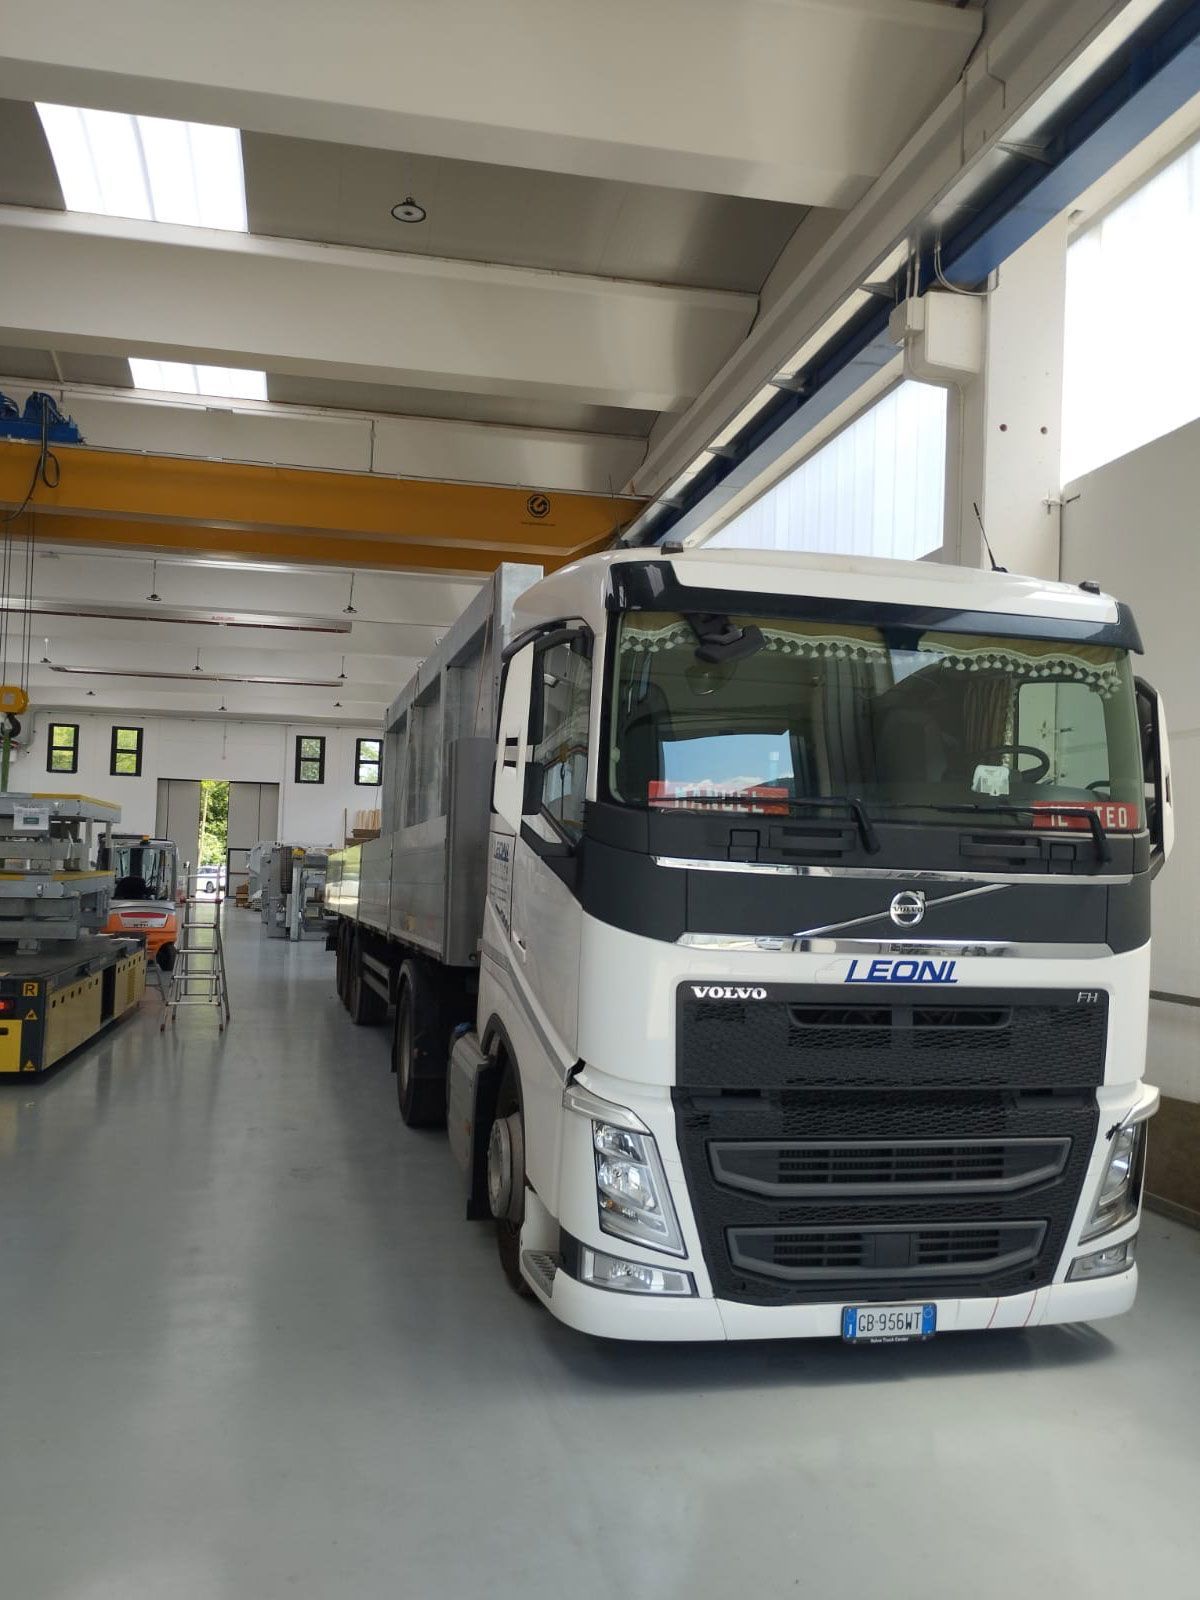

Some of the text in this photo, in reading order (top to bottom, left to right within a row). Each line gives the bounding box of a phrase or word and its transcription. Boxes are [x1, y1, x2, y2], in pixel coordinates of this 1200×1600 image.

[1051, 806, 1127, 828] IL TEO
[844, 959, 958, 983] LEONI
[25, 984, 36, 996] R
[690, 985, 768, 1000] VOLVO
[1077, 991, 1099, 1003] FH
